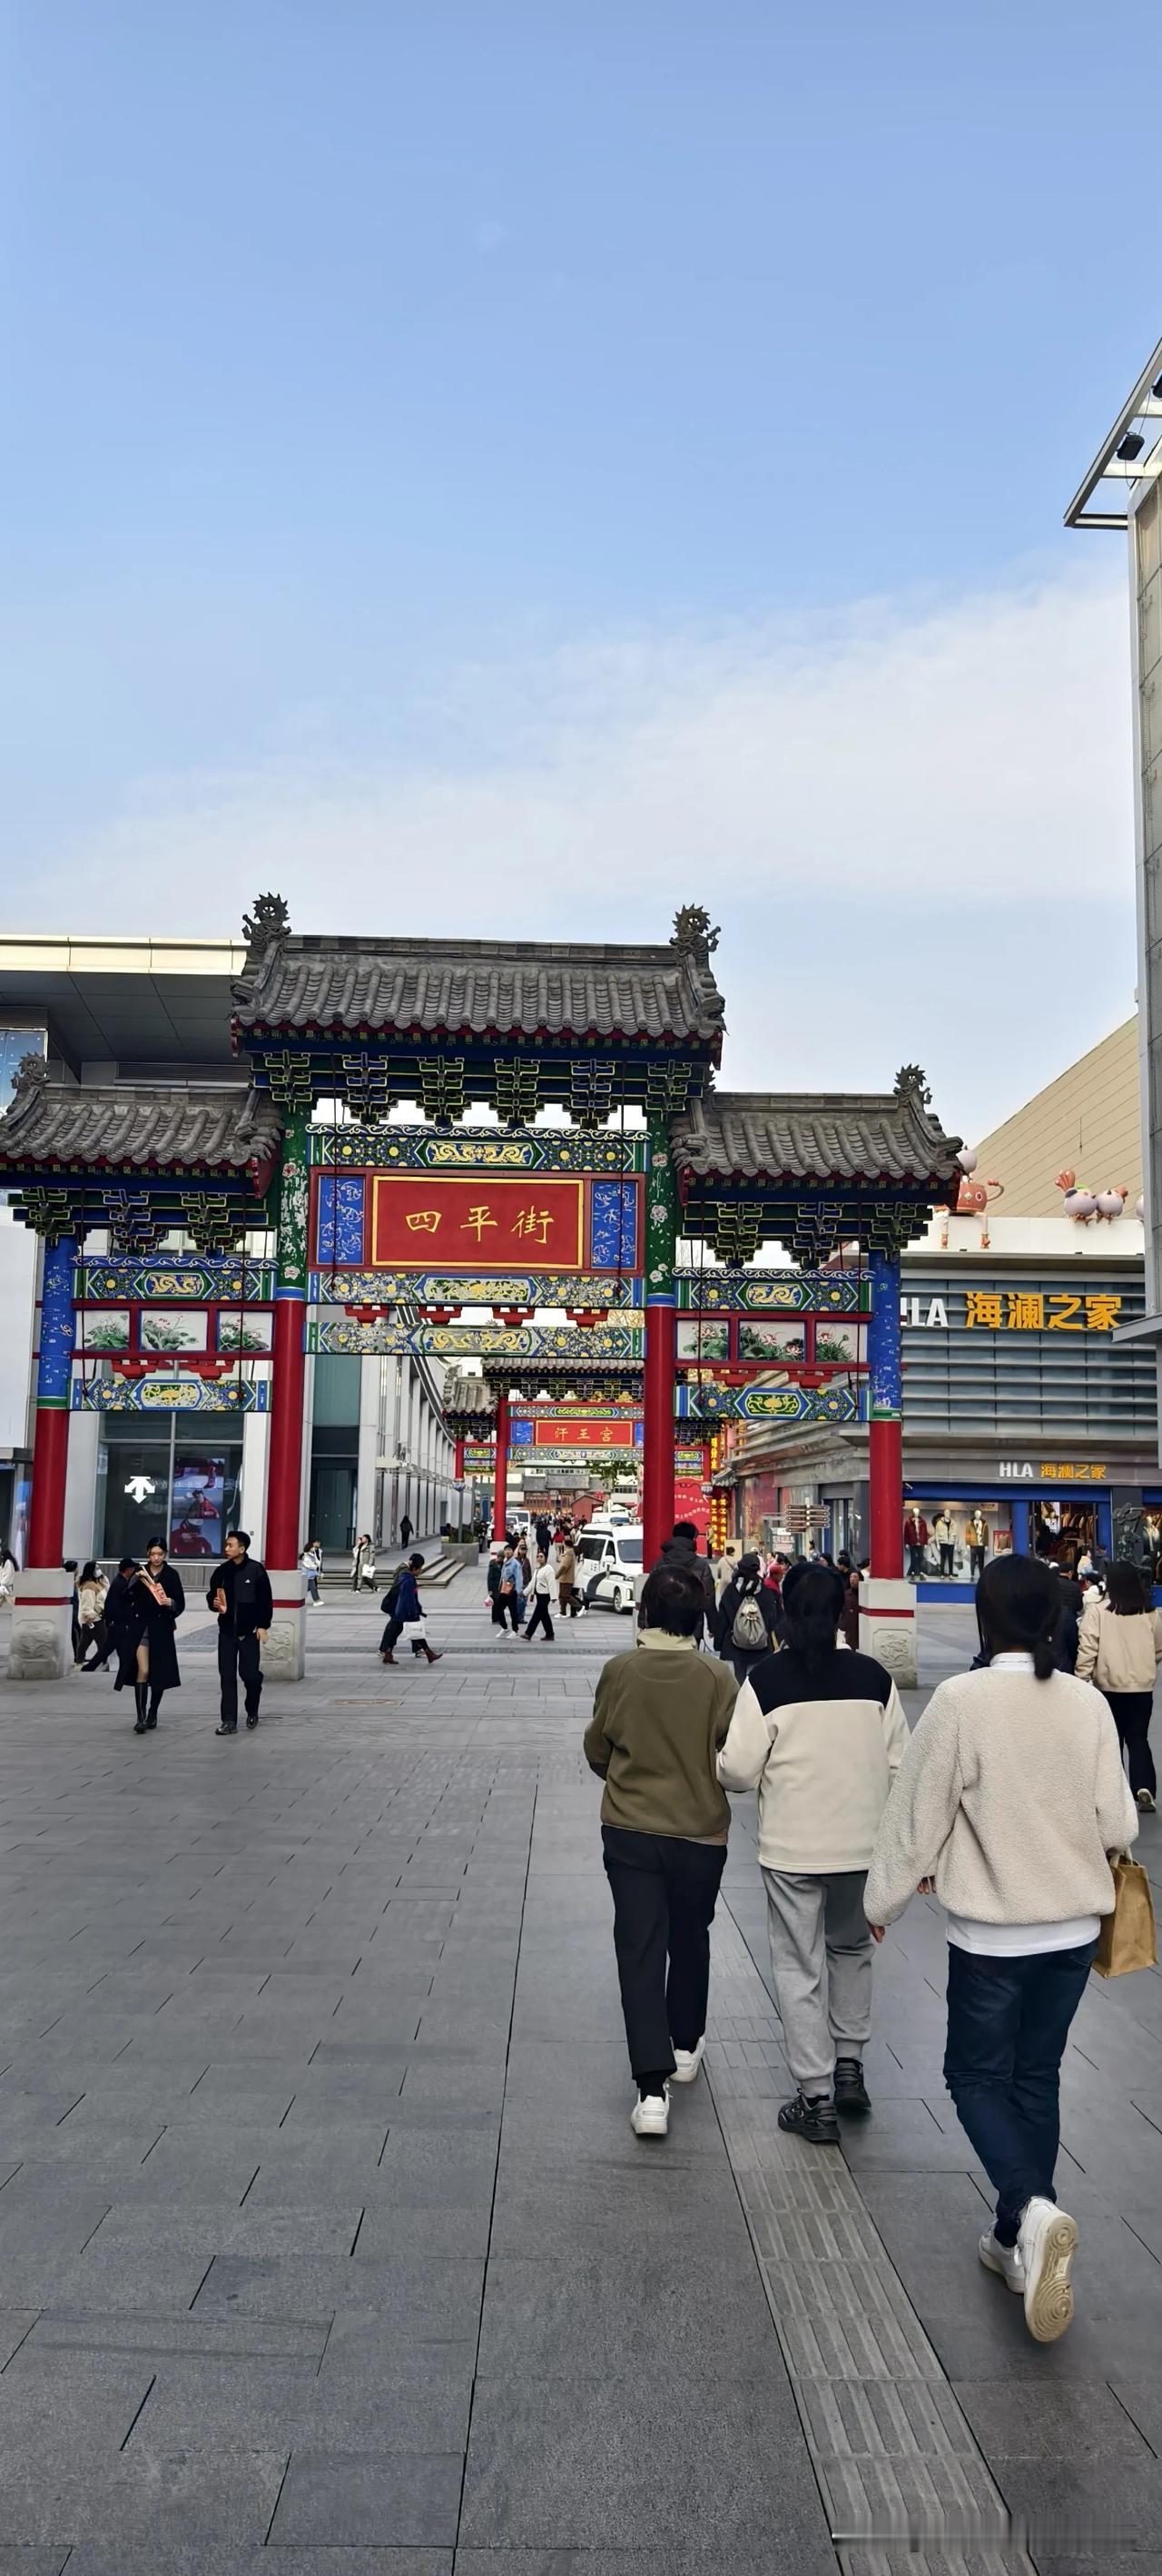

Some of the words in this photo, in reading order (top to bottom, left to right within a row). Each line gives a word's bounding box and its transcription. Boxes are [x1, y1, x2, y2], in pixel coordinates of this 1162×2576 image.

[405, 1205, 555, 1244] 四平街
[965, 1292, 1122, 1330] 海澜之家
[554, 1426, 614, 1442] 汗王宫
[999, 1461, 1034, 1478] HLA
[1039, 1462, 1107, 1479] 海澜之家
